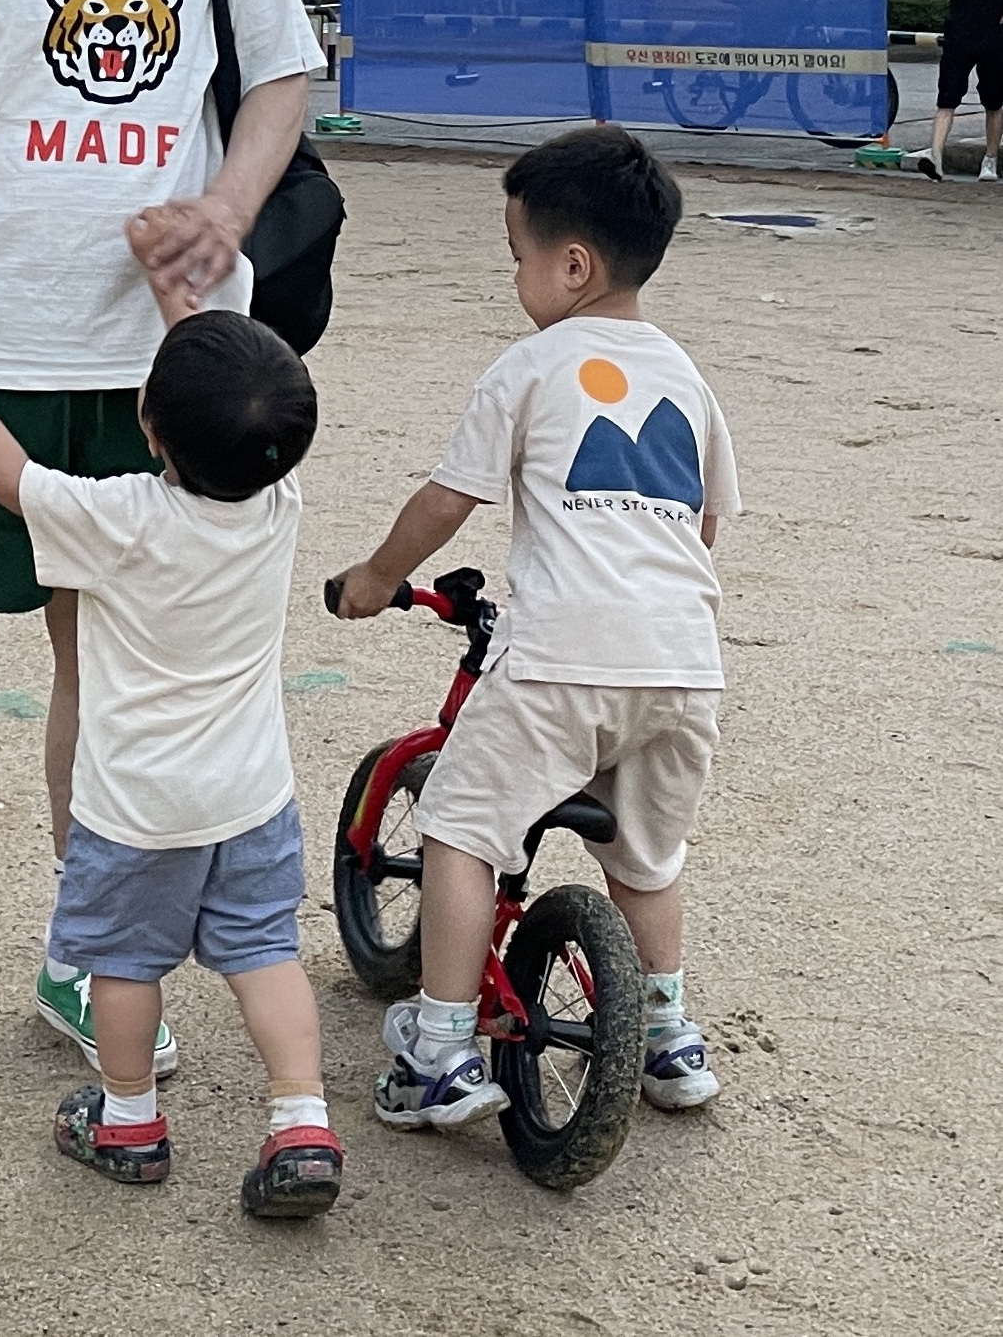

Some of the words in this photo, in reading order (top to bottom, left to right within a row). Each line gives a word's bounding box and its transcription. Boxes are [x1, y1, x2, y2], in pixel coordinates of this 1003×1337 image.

[695, 52, 730, 66] 도로에
[735, 53, 758, 67] 뛰어
[763, 53, 799, 68] 나가지
[26, 119, 180, 168] MADE
[562, 497, 614, 512] NEVER
[621, 498, 647, 511] STO
